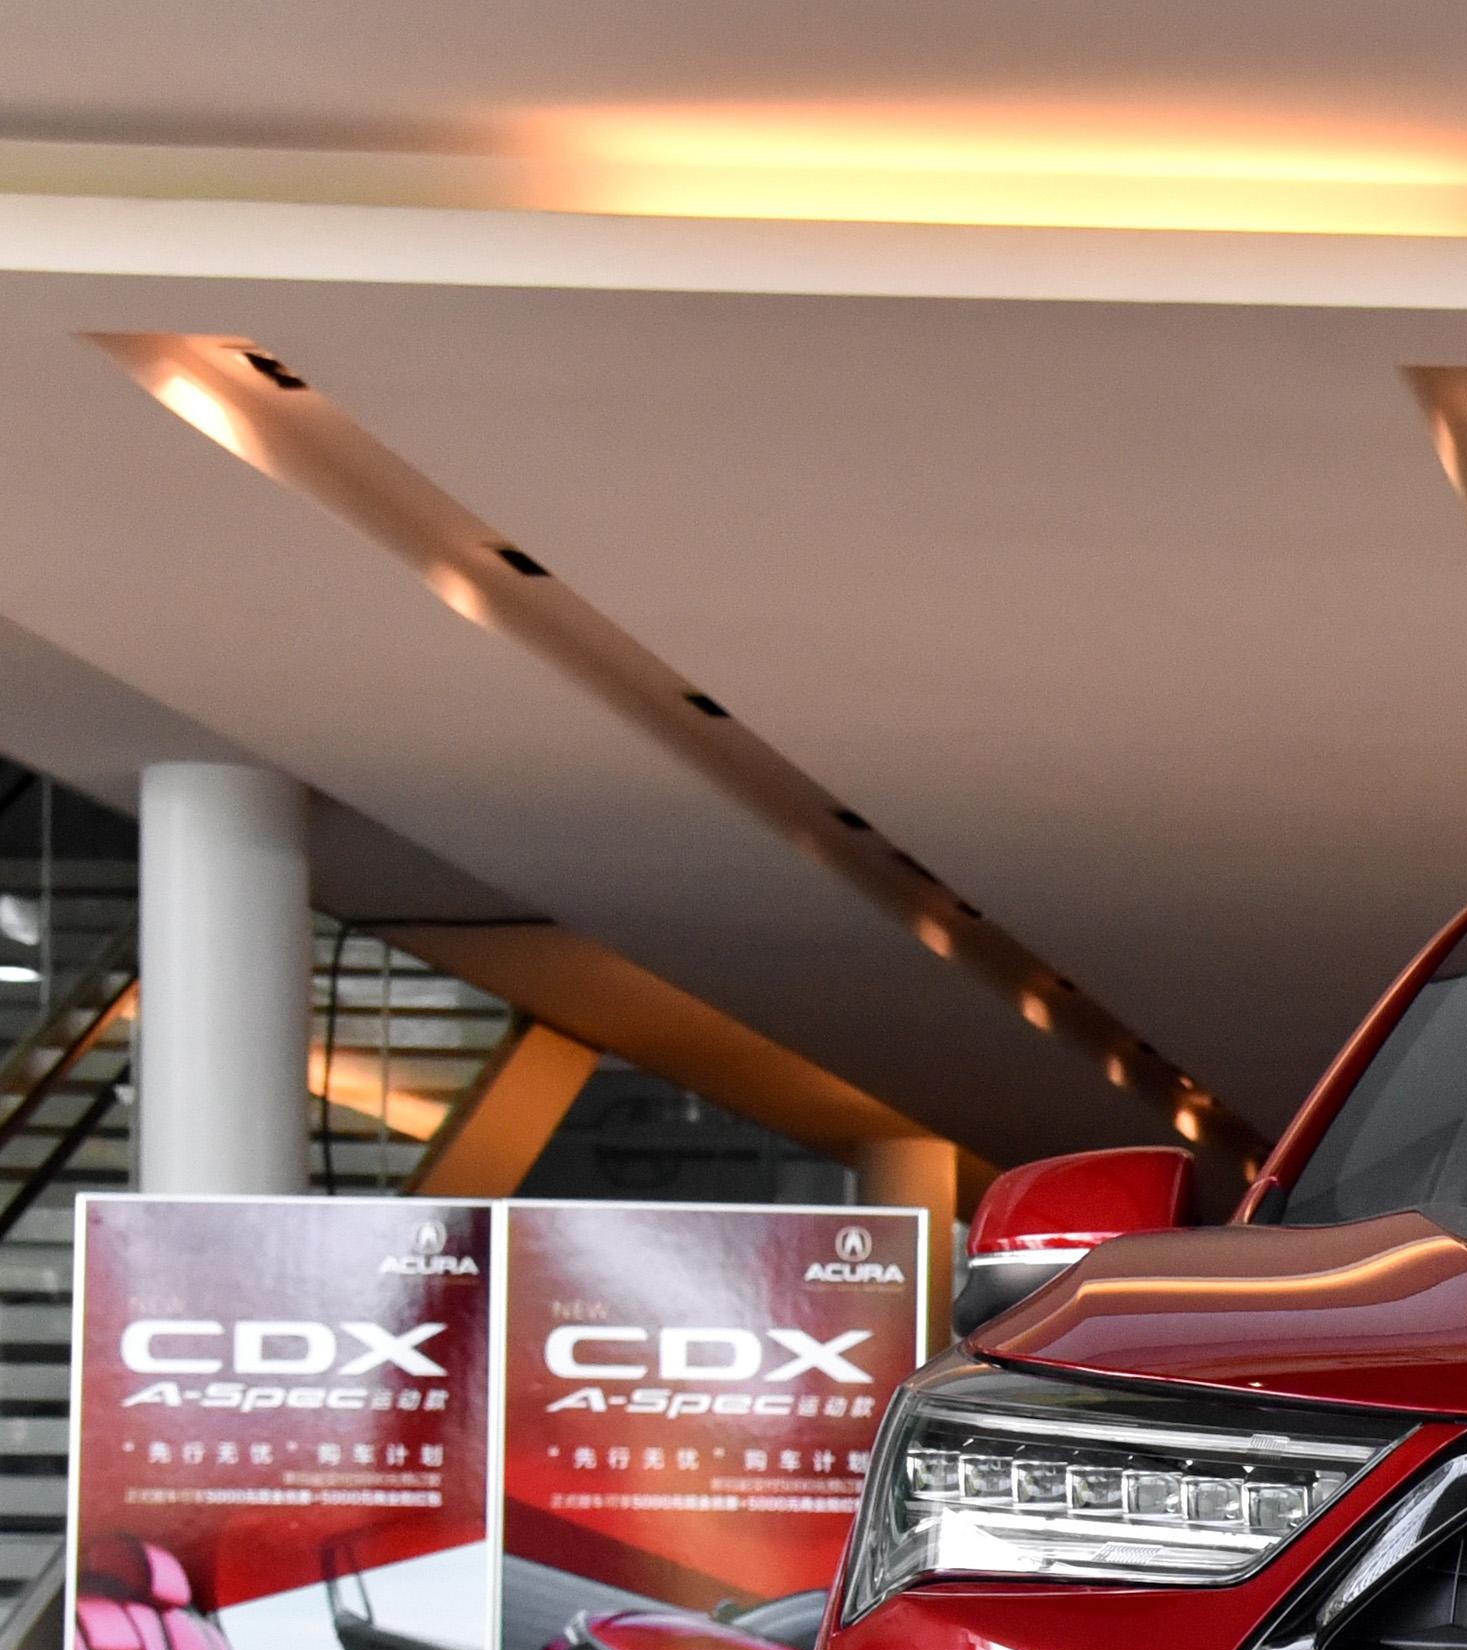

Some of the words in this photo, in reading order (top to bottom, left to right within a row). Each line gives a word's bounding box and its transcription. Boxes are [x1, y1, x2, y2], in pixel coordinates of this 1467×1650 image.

[379, 1256, 479, 1275] ACURA
[804, 1263, 905, 1282] ACURA
[120, 1319, 448, 1377] CDX
[545, 1325, 875, 1384] CDX
[122, 1381, 368, 1413] A-Spec
[546, 1387, 793, 1418] A-Spec
